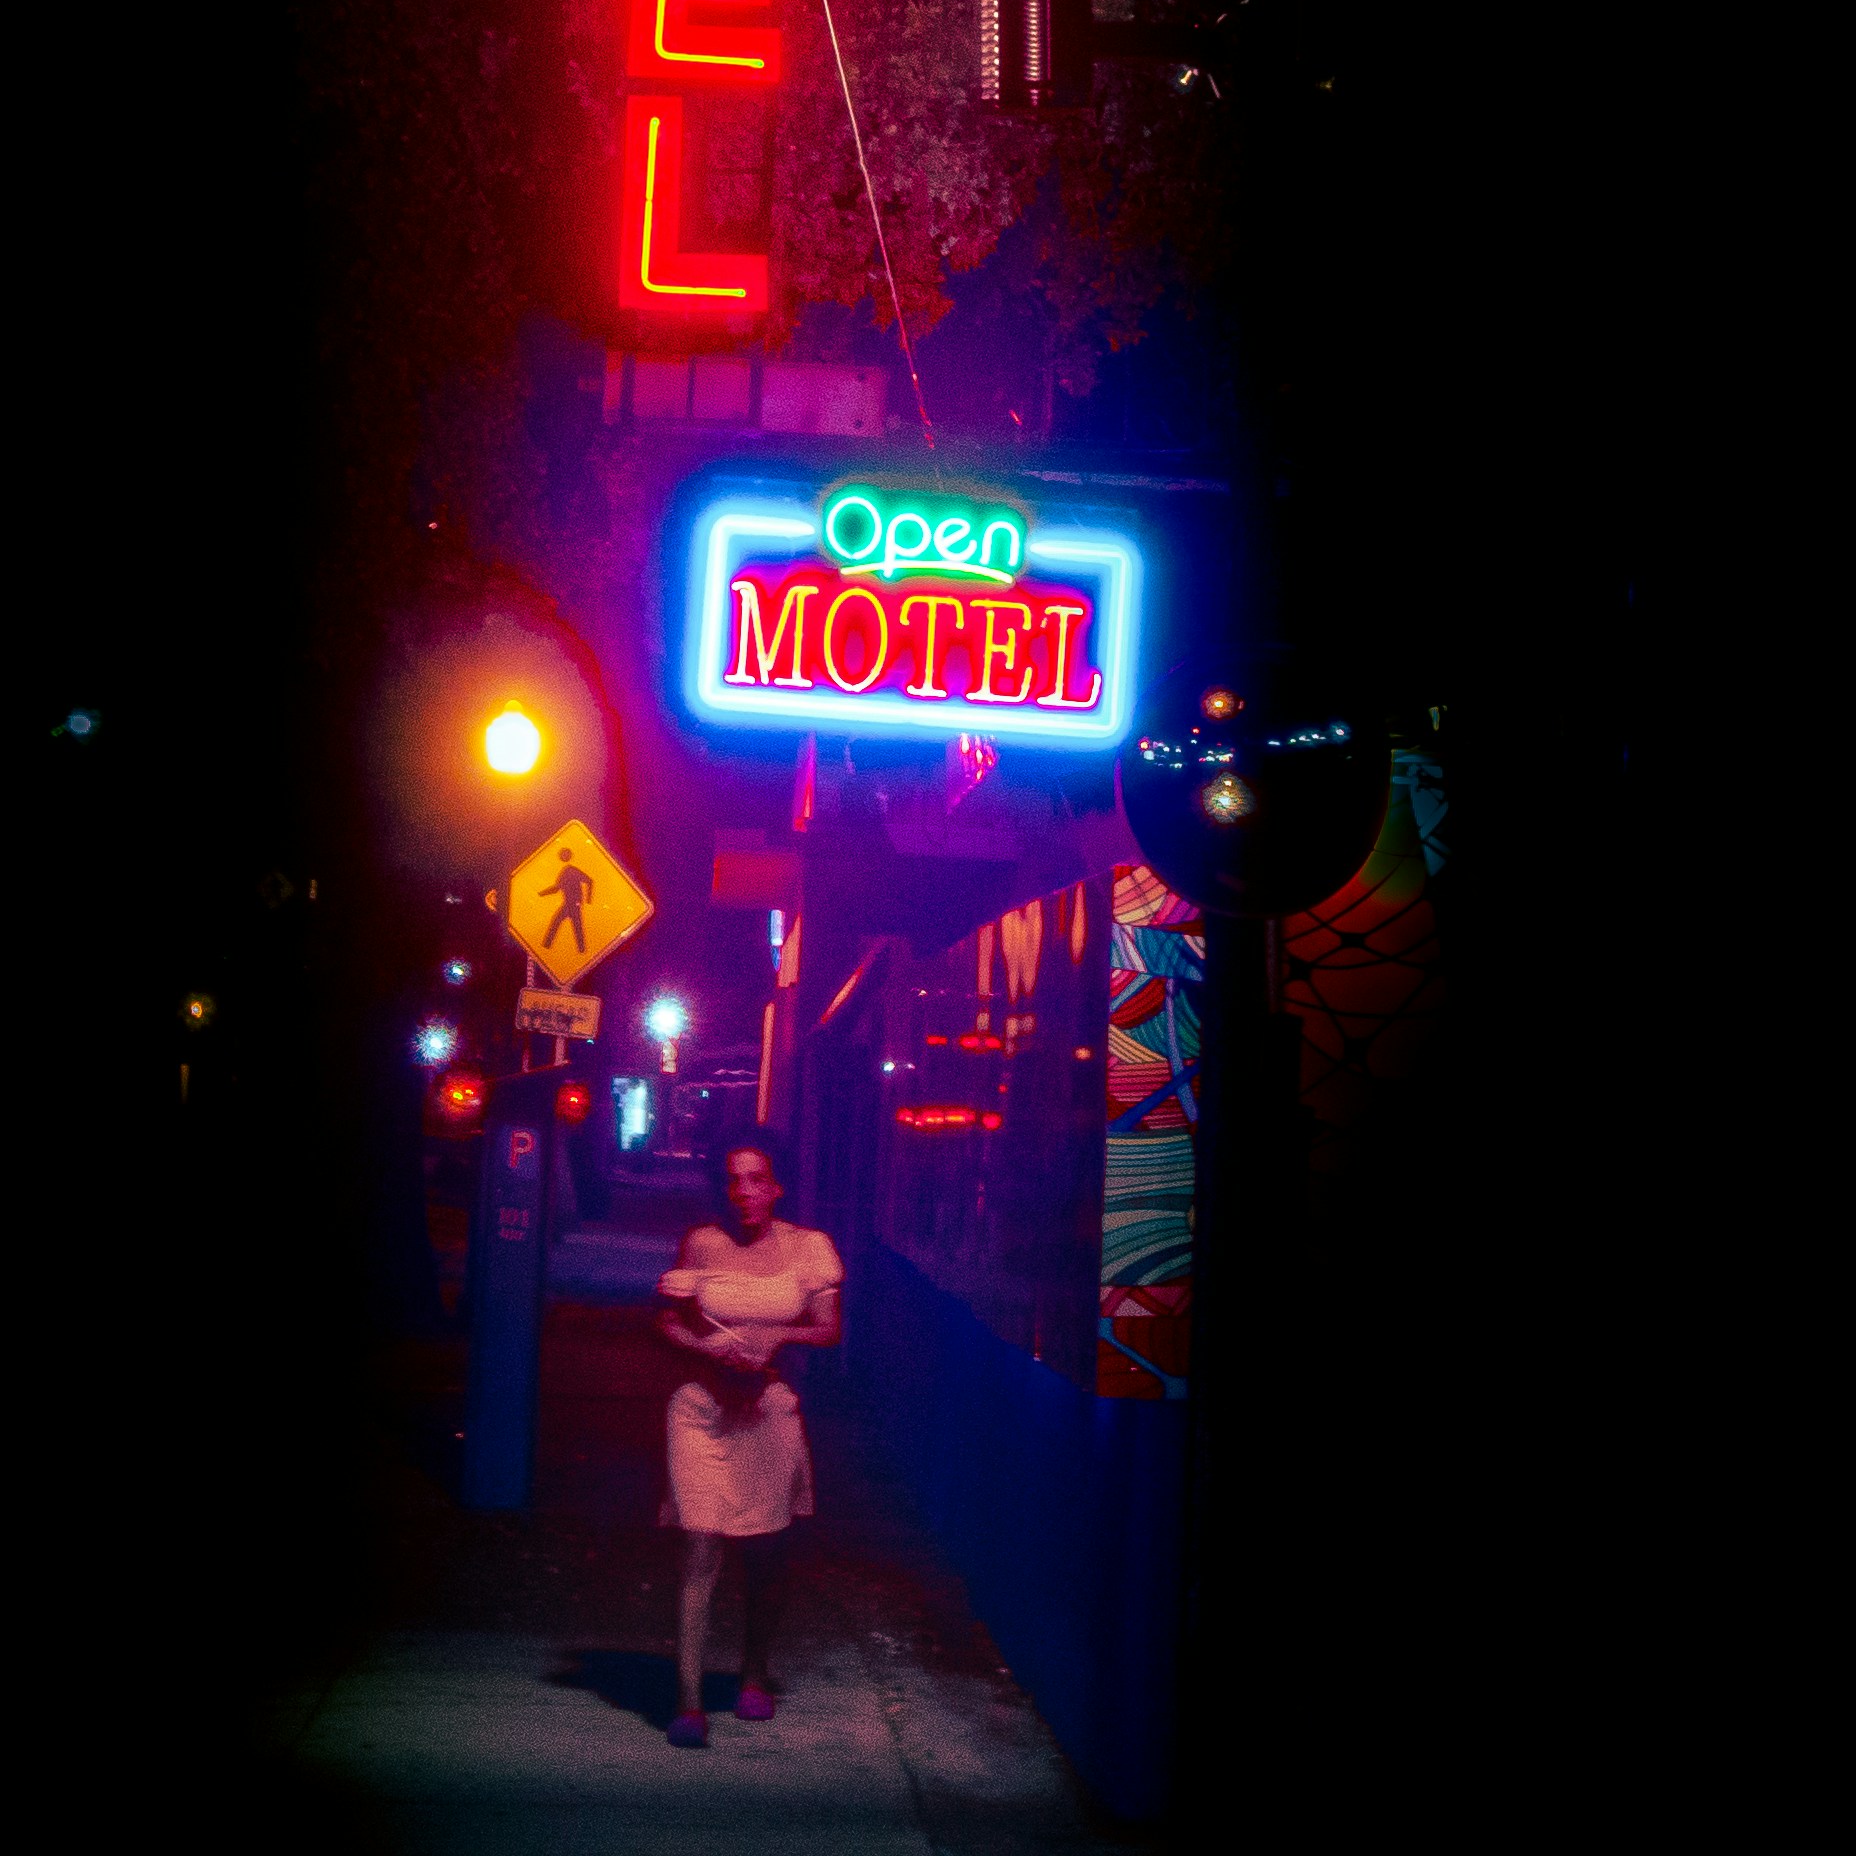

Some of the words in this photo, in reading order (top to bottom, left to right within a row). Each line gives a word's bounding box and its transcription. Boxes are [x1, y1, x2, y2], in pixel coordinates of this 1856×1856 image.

[825, 494, 1021, 579] Open
[724, 578, 1103, 709] MOTEL
[509, 1130, 535, 1169] P
